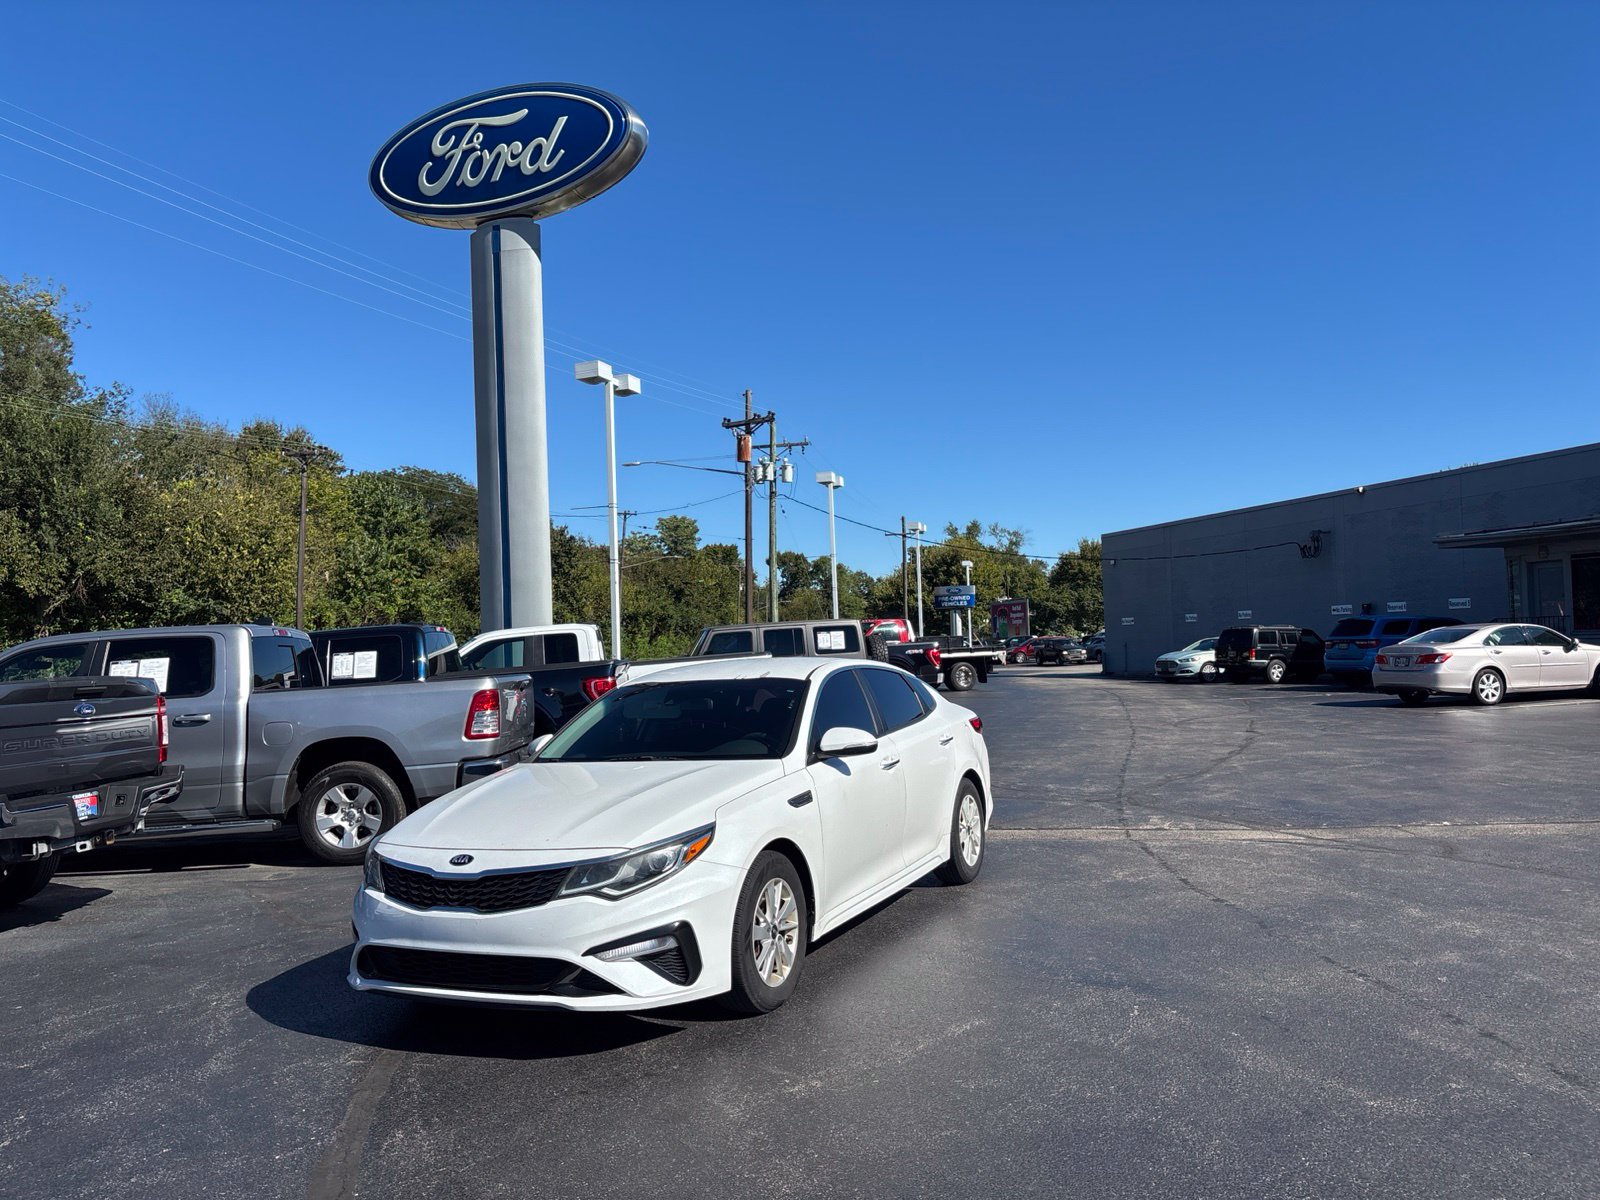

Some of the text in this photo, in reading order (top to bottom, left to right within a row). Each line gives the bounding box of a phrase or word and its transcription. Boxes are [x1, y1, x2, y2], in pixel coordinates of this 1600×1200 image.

[417, 108, 568, 196] Ford
[3, 727, 149, 752] SUPER DUTY
